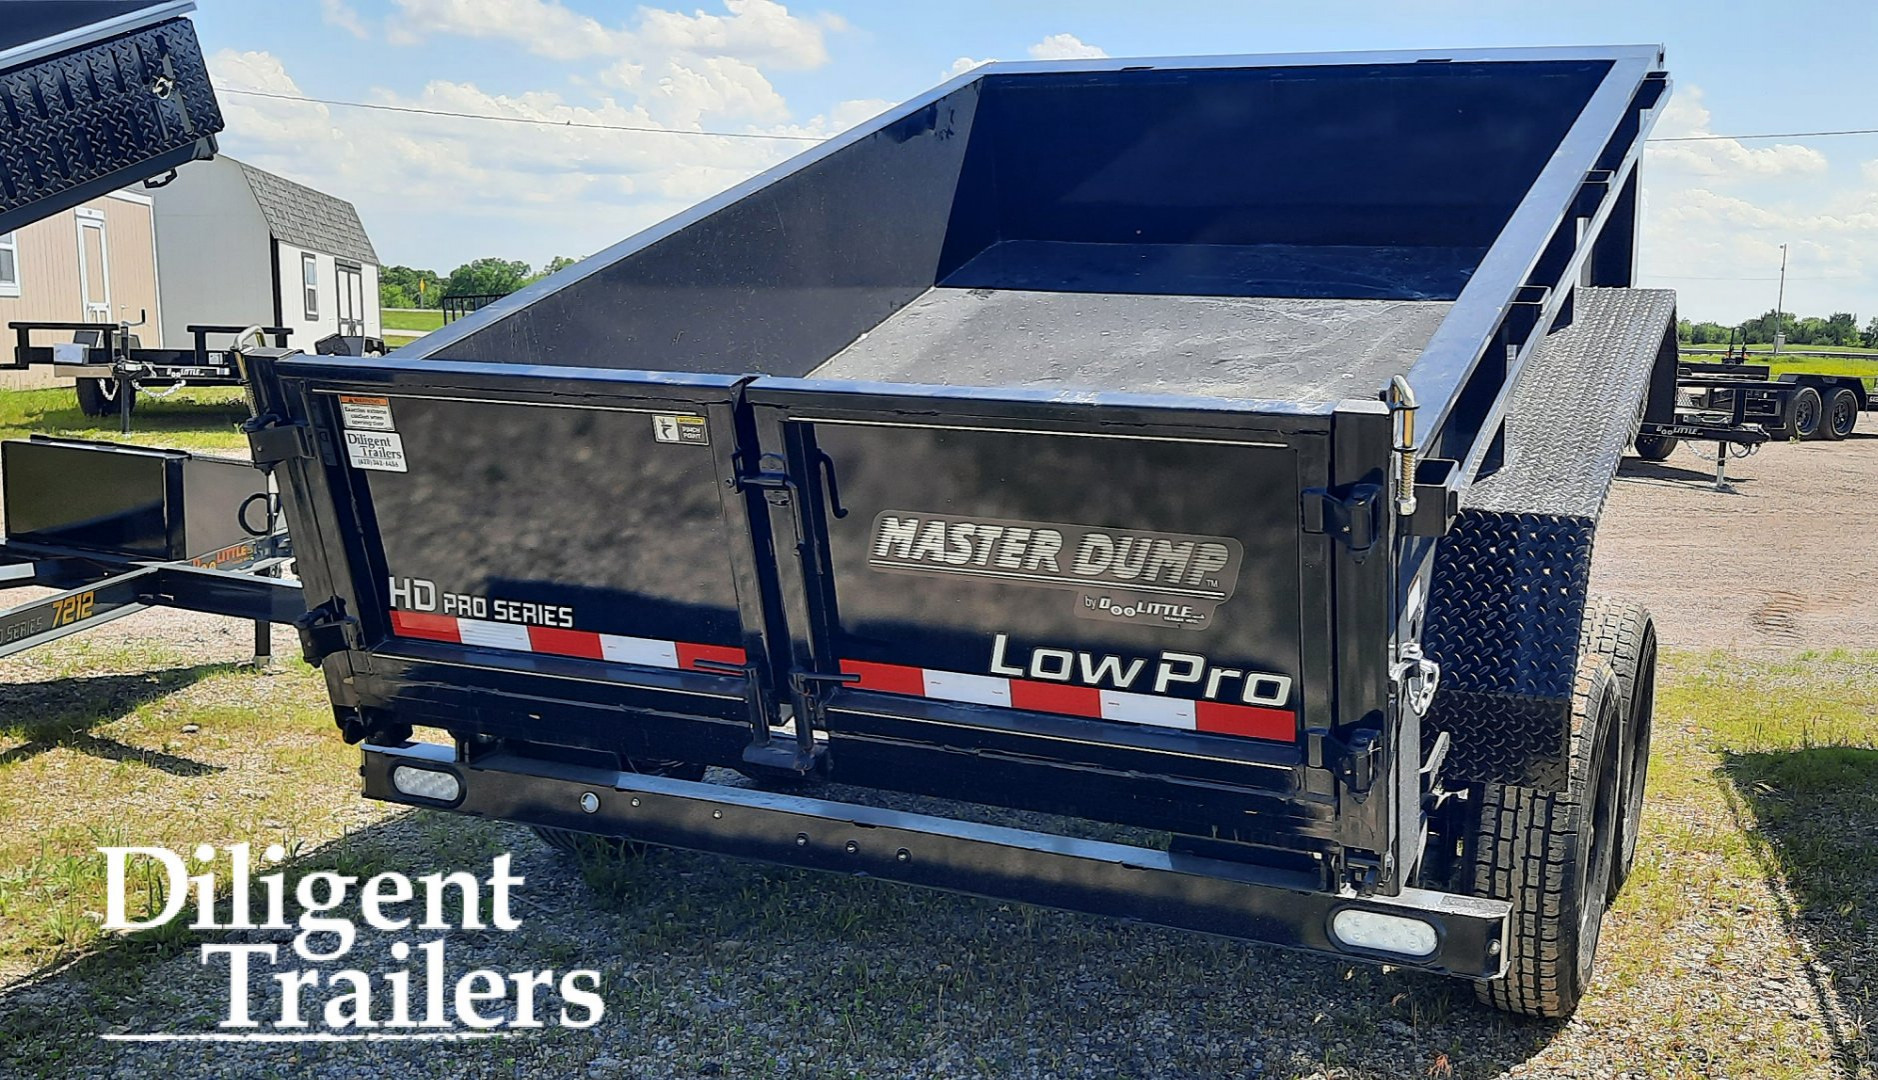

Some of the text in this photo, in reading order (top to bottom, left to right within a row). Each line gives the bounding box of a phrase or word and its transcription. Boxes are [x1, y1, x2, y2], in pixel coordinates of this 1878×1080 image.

[346, 433, 391, 449] Diligent
[359, 446, 402, 459] Trailers
[873, 516, 1064, 573] MASTER
[1070, 532, 1229, 586] DUMP
[52, 591, 95, 628] 7212
[388, 576, 573, 628] HD PRO SERIES
[1084, 596, 1097, 609] by
[6, 616, 42, 642] SERIES
